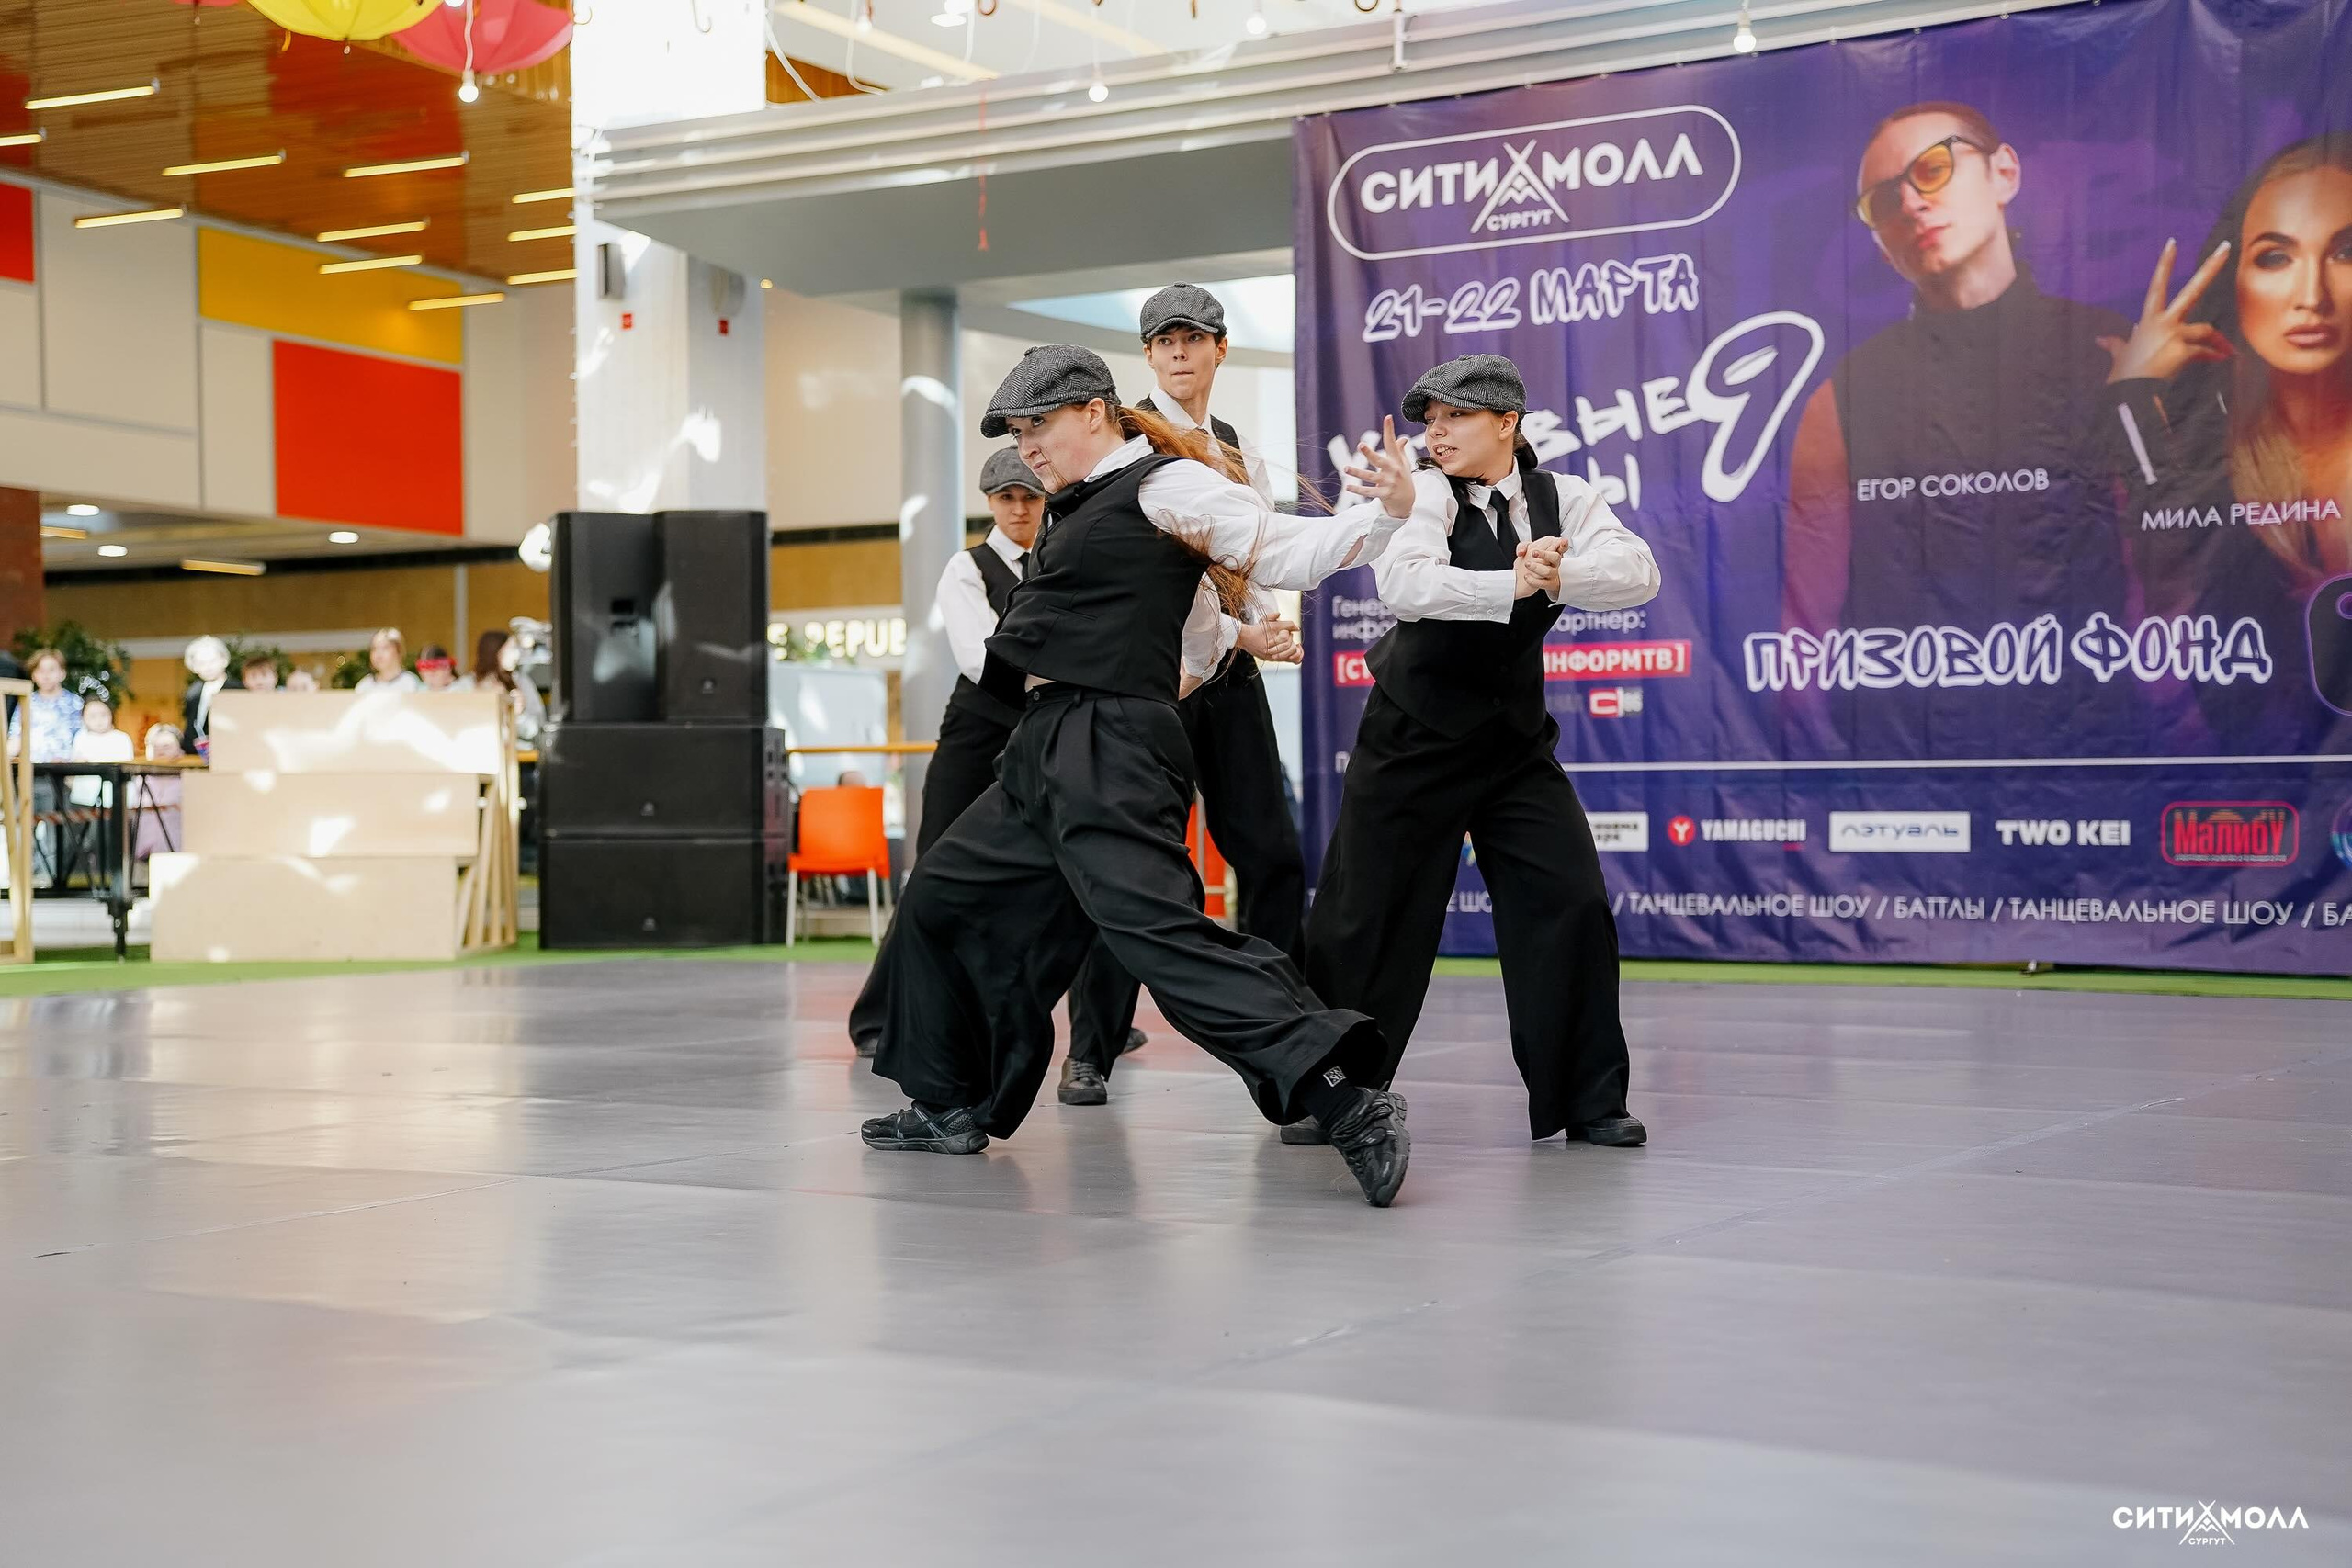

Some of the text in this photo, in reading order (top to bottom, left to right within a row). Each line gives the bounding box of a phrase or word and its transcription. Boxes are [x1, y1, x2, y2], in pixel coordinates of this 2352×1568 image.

[1486, 208, 1555, 232] СУРГУТ
[1363, 253, 1700, 343] 21-22 МАРТА
[1856, 468, 2050, 502] ЕГОР СОКОЛОВ
[2141, 497, 2342, 531] МИЛА РЕДИНА
[1551, 609, 1647, 636] артнер:
[1744, 612, 2274, 693] ПРИЗОВОЙ ФОНД
[1700, 819, 1807, 842] YAMAGUCHI
[1994, 820, 2132, 847] TWO KEI
[1627, 892, 1806, 918] ТАНЦЕВАЛЬНОЕ
[1809, 895, 1871, 919] ШОУ
[1894, 894, 1985, 920] БАТТЛЫ
[2008, 897, 2216, 924] ТАНЦЕВАЛЬНОЕ
[2222, 900, 2294, 925] ШОУ
